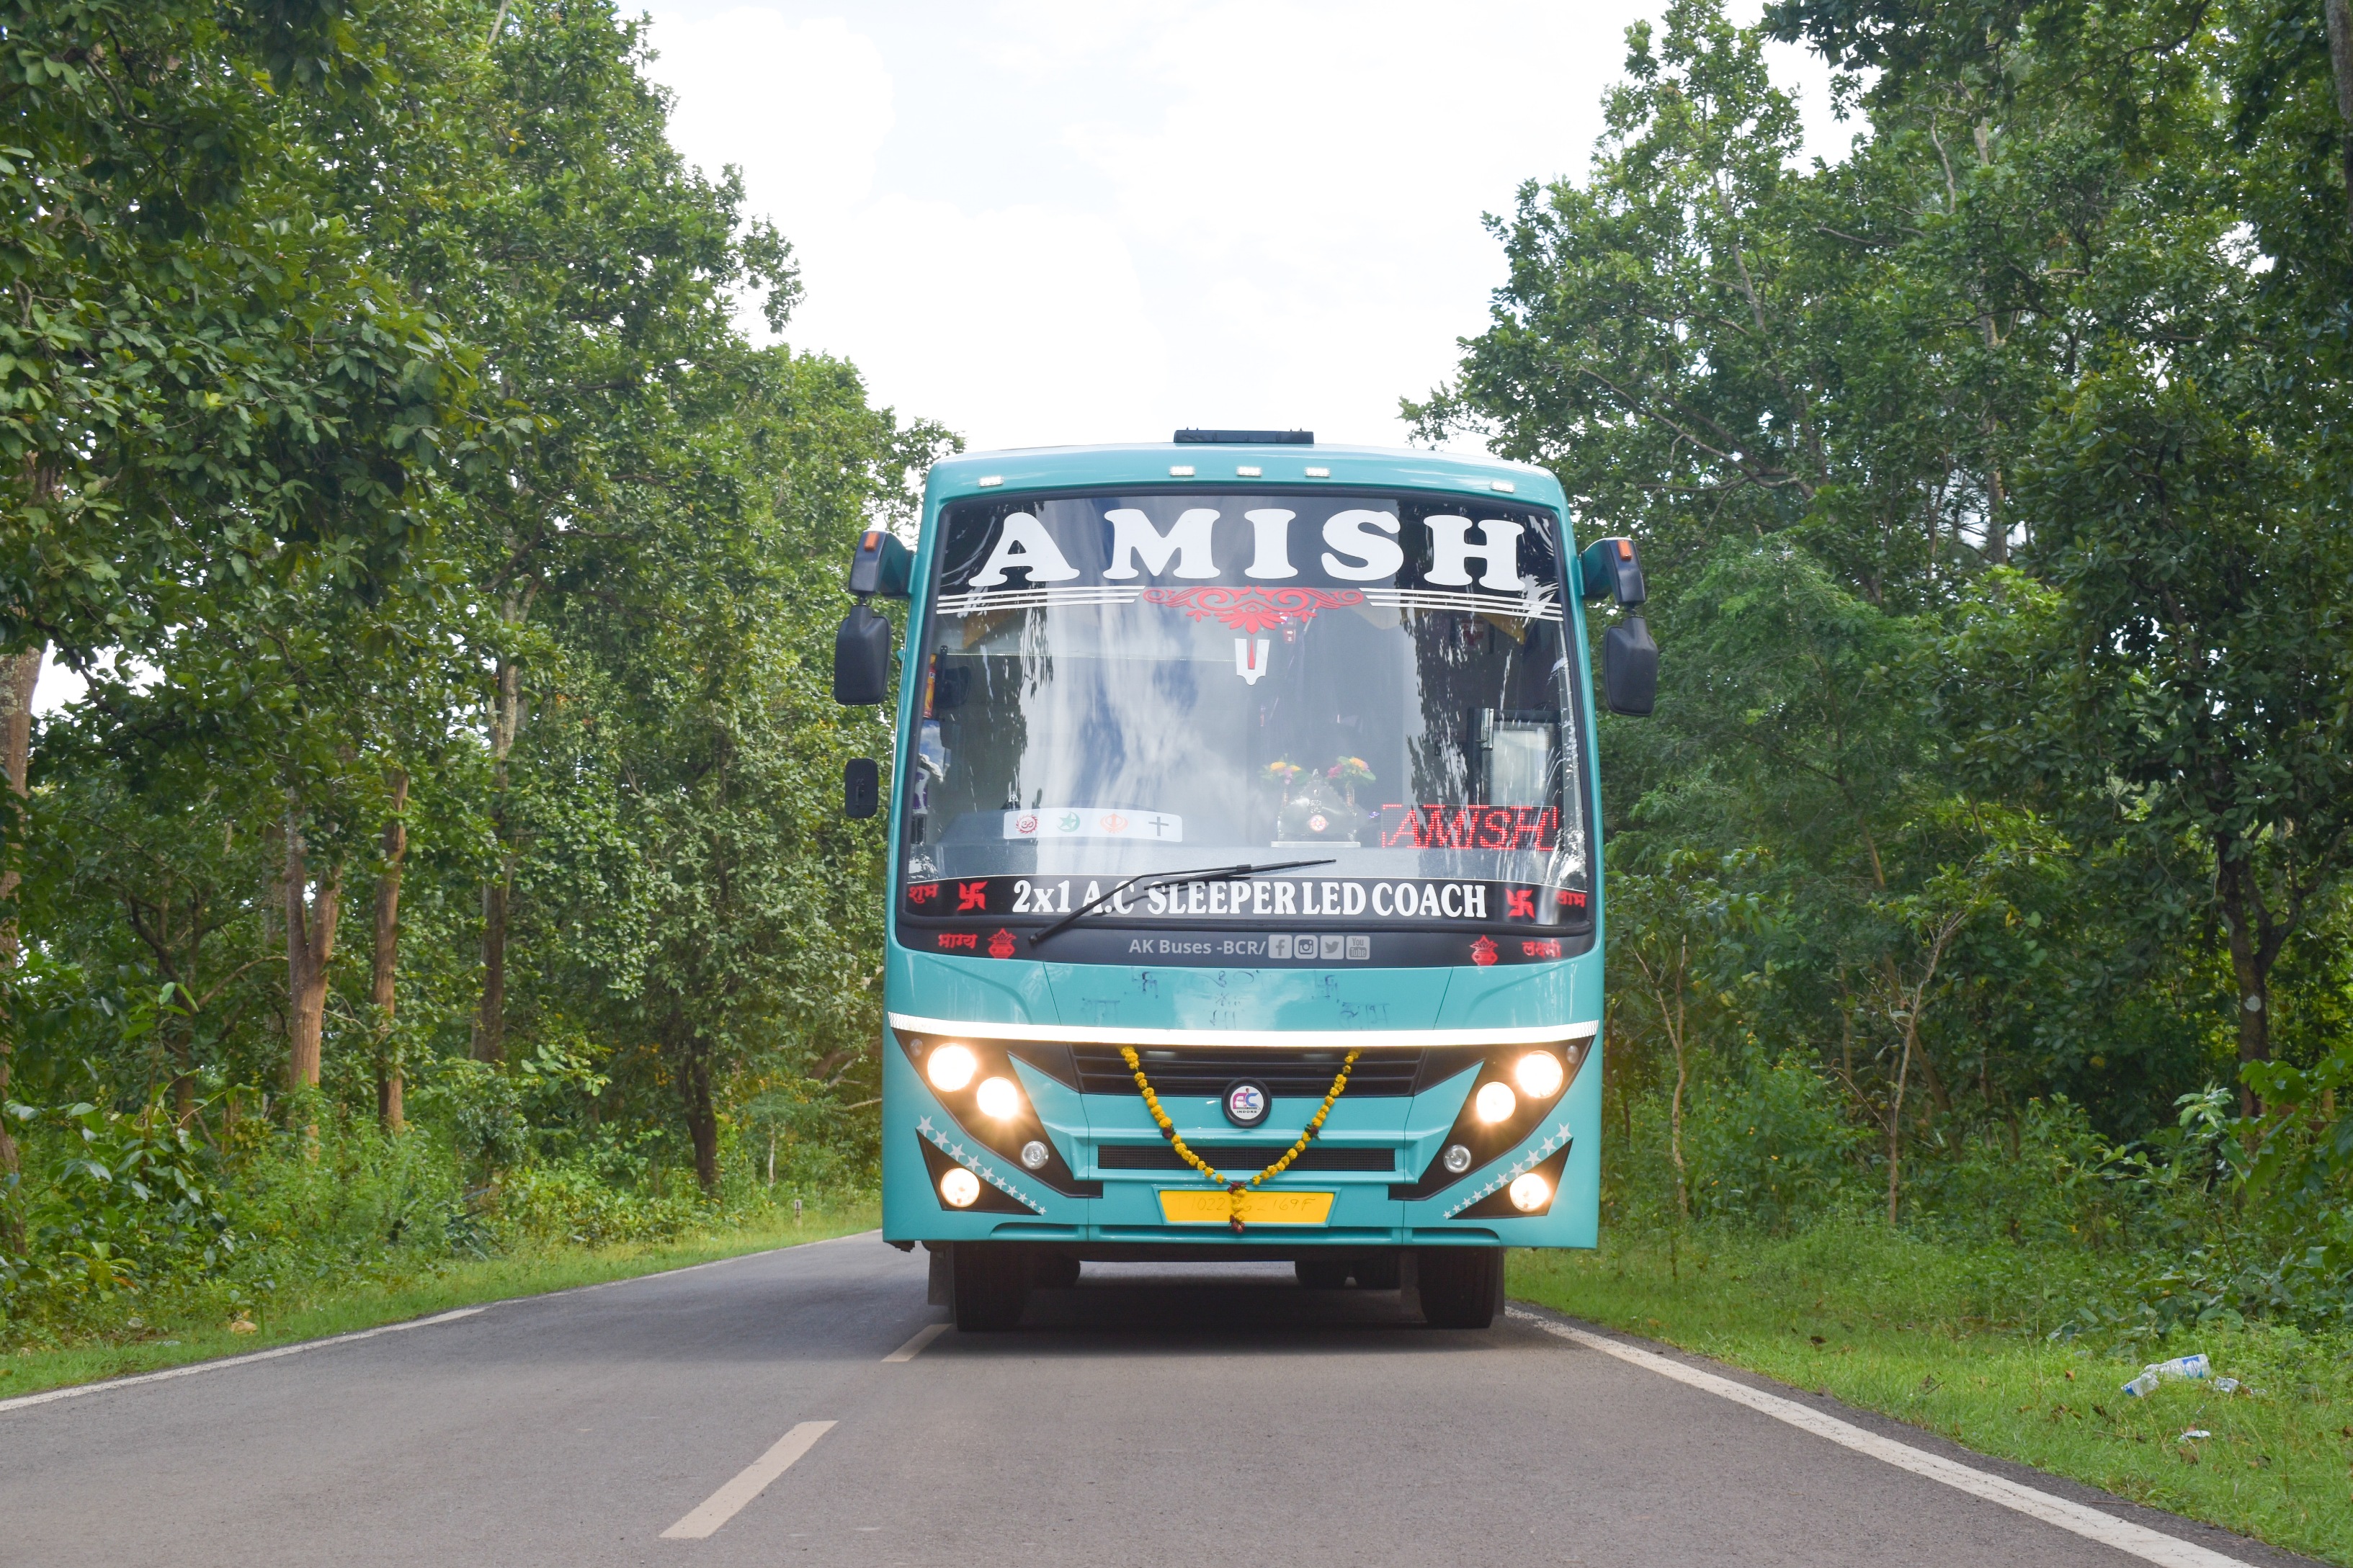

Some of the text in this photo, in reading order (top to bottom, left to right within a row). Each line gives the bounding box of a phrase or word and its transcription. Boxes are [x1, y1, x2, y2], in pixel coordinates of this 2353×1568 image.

[968, 507, 1526, 592] AMISH
[1387, 810, 1550, 851] AMISH
[908, 884, 939, 904] शुभ
[1012, 879, 1071, 913] 2x1
[1147, 880, 1297, 915] SLEEPER
[1302, 881, 1367, 915] LED
[1371, 882, 1487, 918] COACH
[938, 933, 978, 949] भाग्य
[1128, 939, 1154, 954] AK
[1159, 939, 1212, 954] Buses
